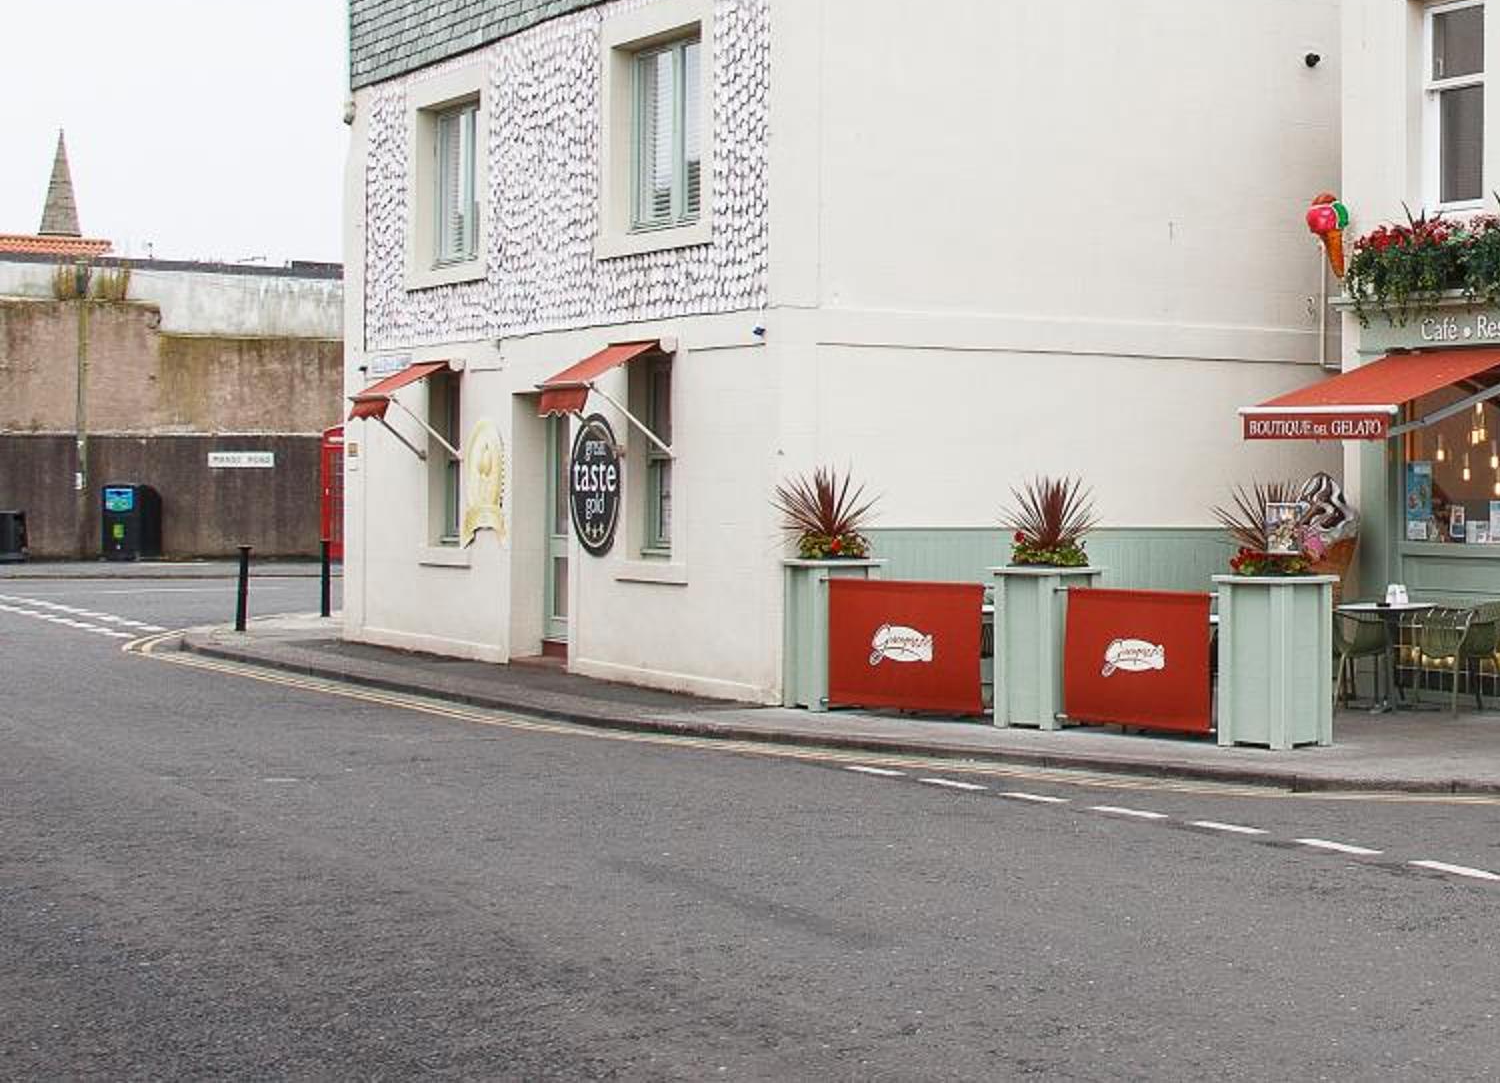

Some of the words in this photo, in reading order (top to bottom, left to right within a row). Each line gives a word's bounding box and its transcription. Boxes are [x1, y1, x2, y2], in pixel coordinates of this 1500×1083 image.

[1421, 317, 1458, 340] Café
[1249, 420, 1312, 436] BOUTIQUE
[1313, 424, 1327, 433] DEL
[1331, 419, 1382, 436] GELATO
[585, 440, 607, 461] great
[573, 462, 617, 492] taste
[585, 494, 604, 520] gold
